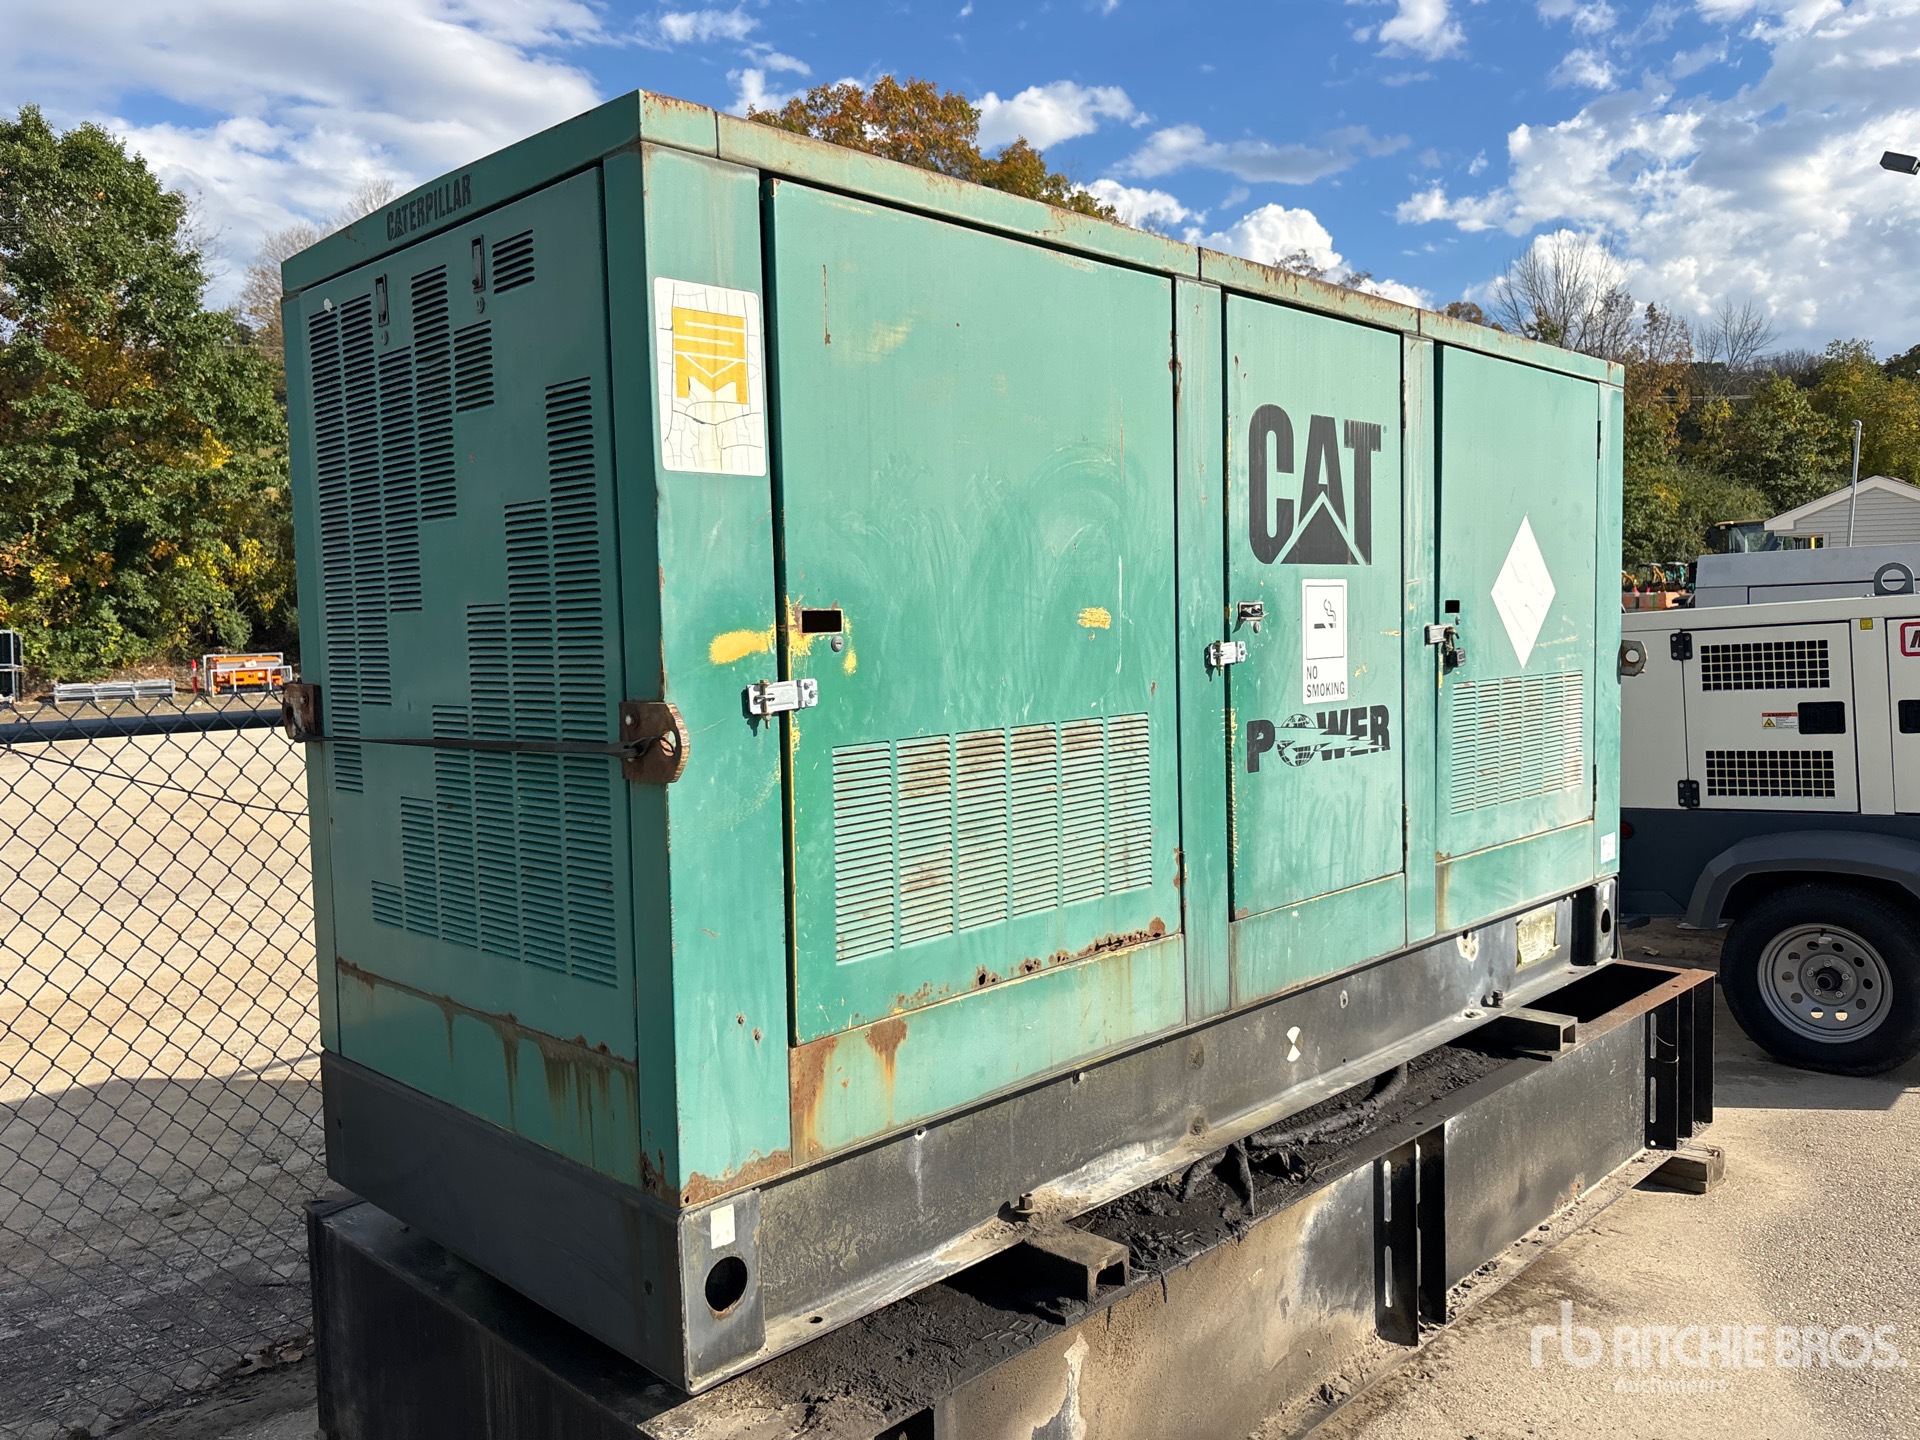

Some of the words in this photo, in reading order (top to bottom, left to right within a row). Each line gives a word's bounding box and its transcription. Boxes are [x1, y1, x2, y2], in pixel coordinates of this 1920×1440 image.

[387, 173, 472, 241] CATERPILLAR
[1249, 404, 1382, 566] CAT
[1306, 665, 1318, 680] NO
[1306, 681, 1345, 698] SMOKING
[1246, 704, 1391, 774] POWER
